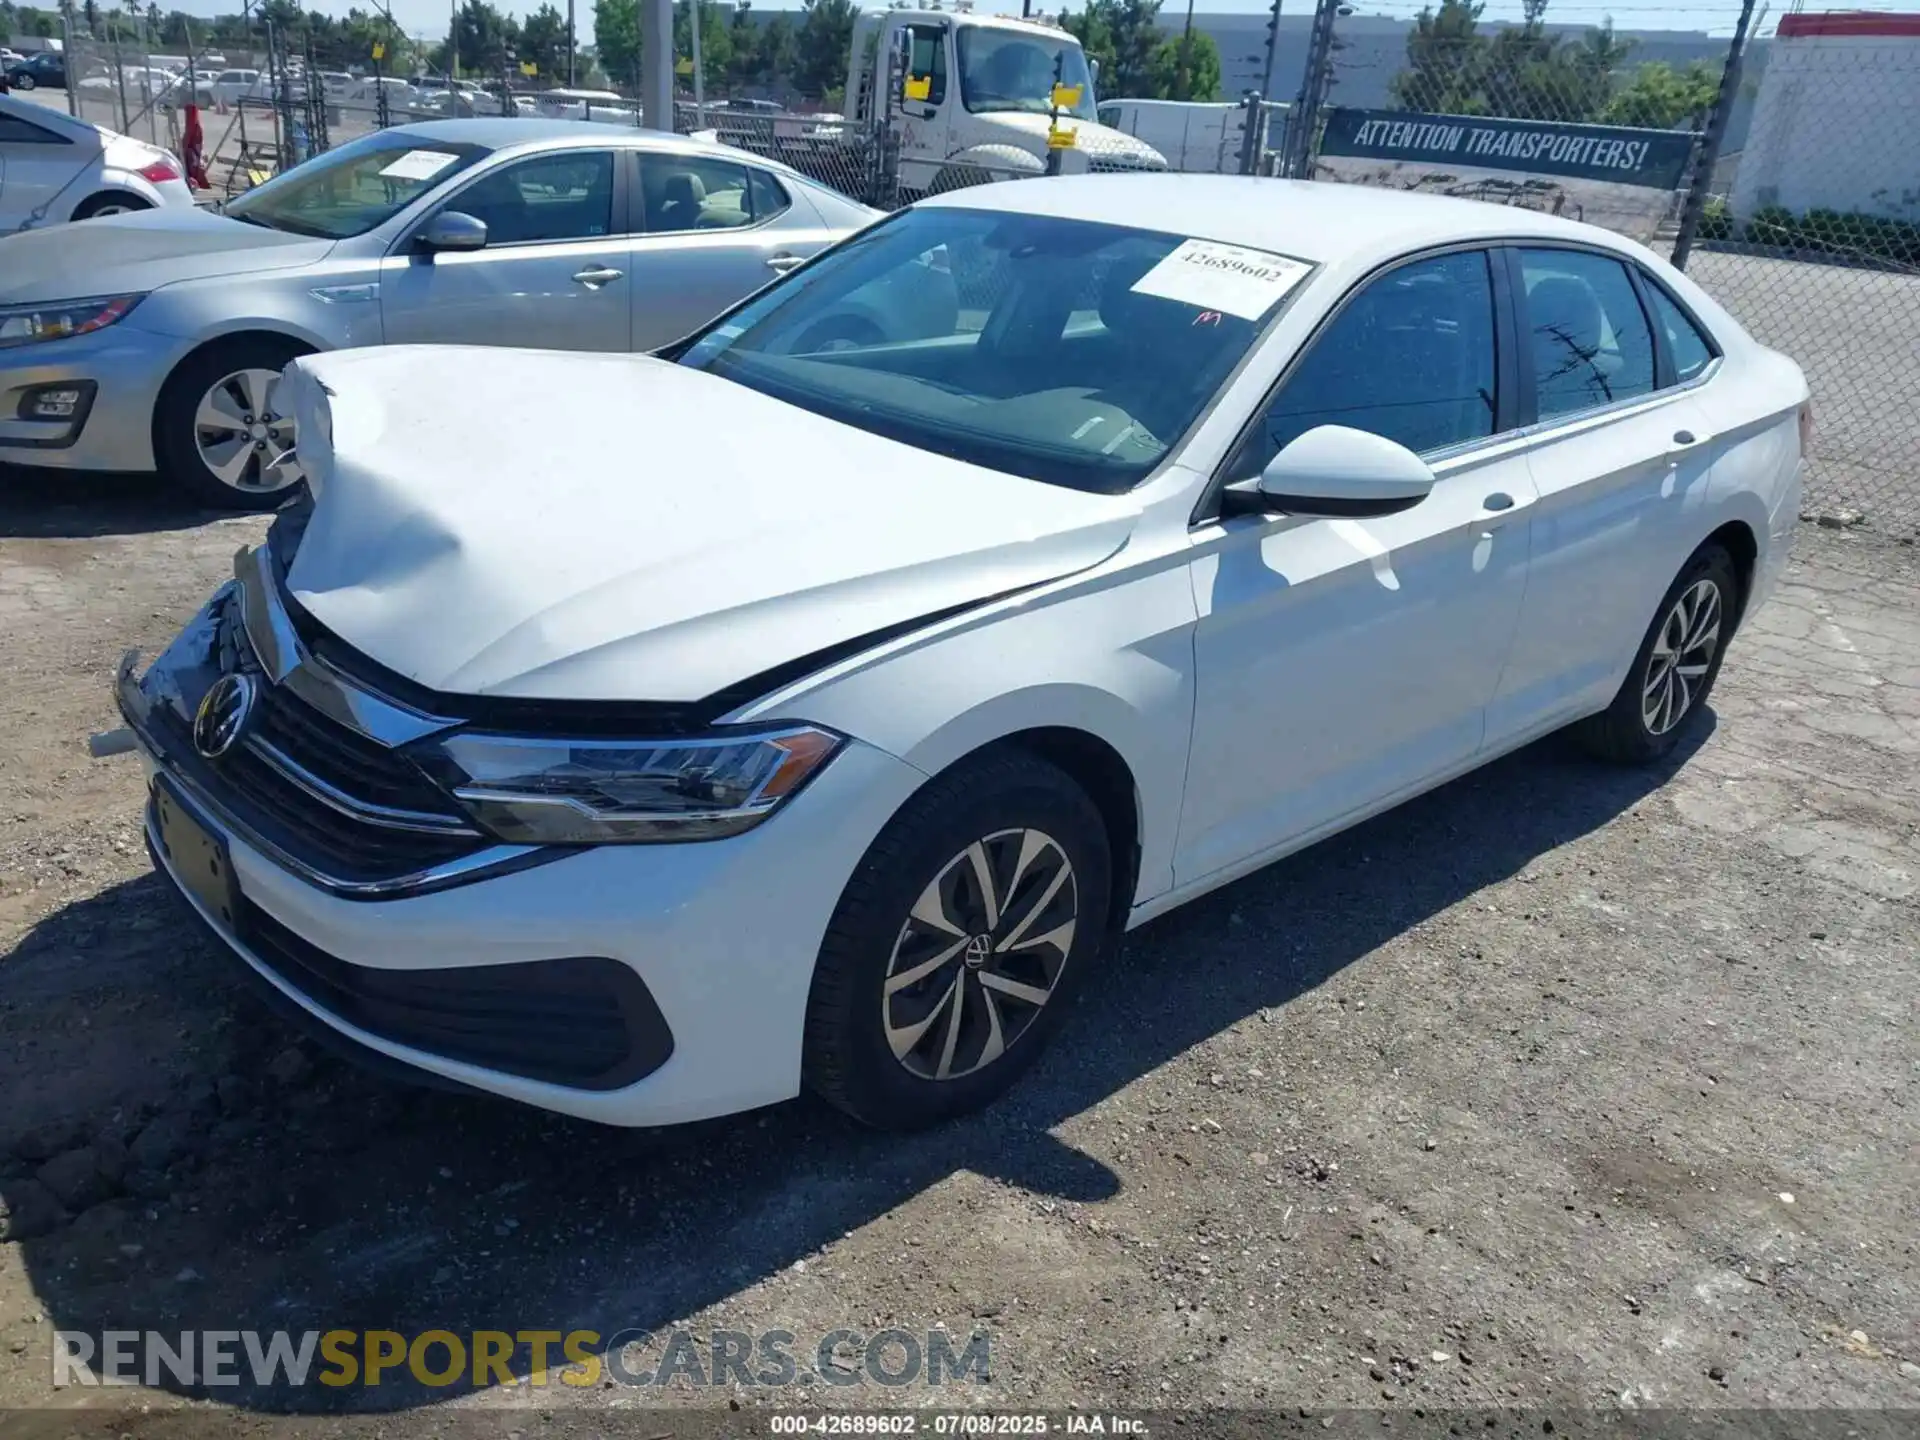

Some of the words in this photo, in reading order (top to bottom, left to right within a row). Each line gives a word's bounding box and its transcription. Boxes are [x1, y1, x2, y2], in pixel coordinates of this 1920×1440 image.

[1353, 119, 1465, 152] ATTENTION
[1465, 127, 1649, 171] TRANSPORTERS!
[1181, 251, 1283, 283] 42689602
